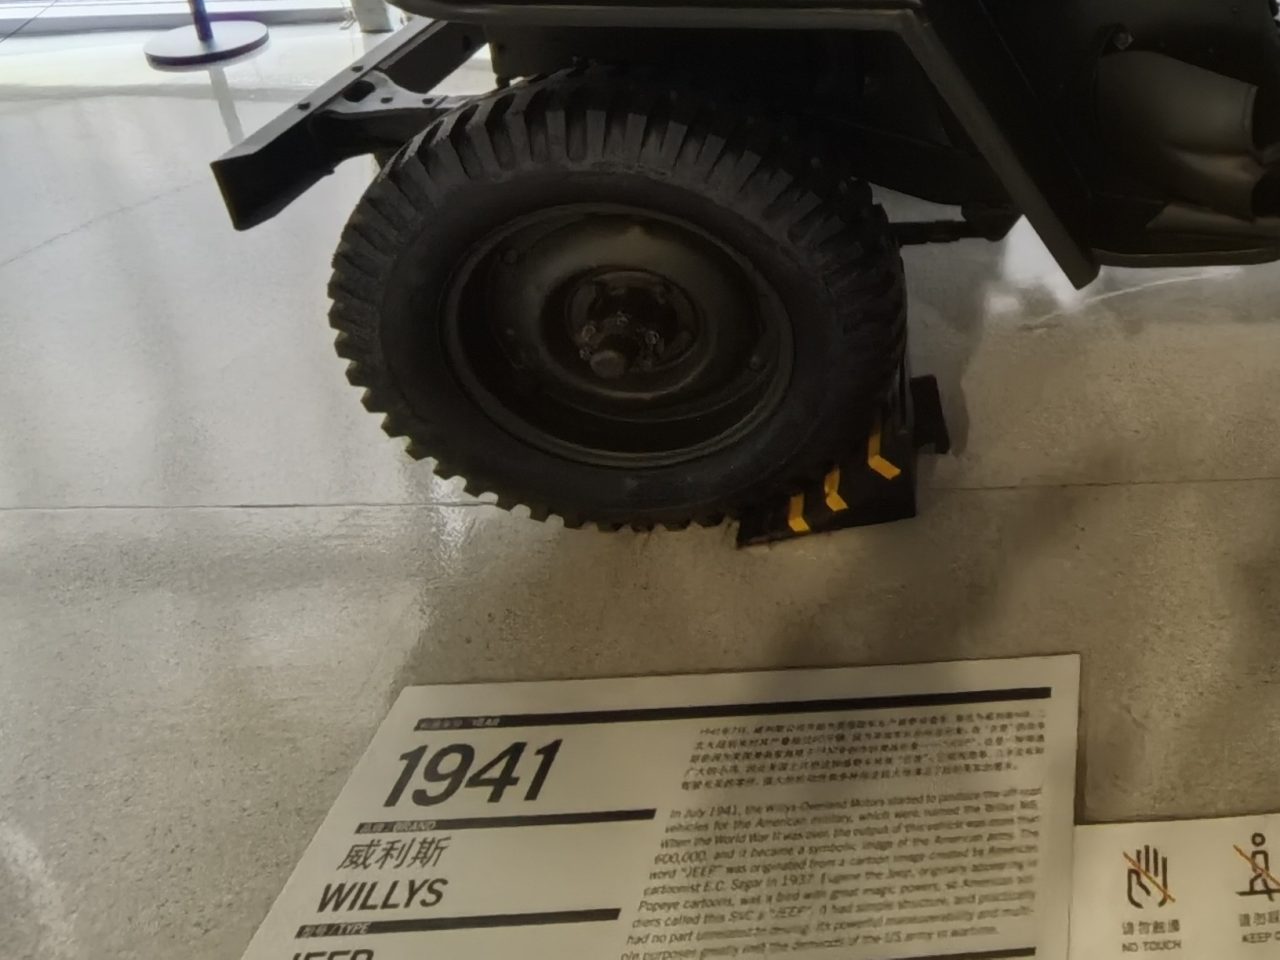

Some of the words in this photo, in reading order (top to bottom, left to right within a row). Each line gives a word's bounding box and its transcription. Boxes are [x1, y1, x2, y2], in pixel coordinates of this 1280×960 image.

[383, 739, 563, 807] 1941
[685, 809, 705, 818] July
[710, 806, 741, 817] 1941,
[337, 836, 451, 871] 威利斯
[650, 870, 676, 880] word
[317, 878, 449, 913] WILLYS
[639, 901, 680, 912] Popeye
[665, 913, 699, 926] called
[627, 935, 649, 945] had
[652, 934, 666, 944] no
[670, 931, 693, 944] part
[1242, 932, 1272, 943] KEEP
[1122, 942, 1139, 952] NO
[1143, 940, 1181, 951] TOUCH
